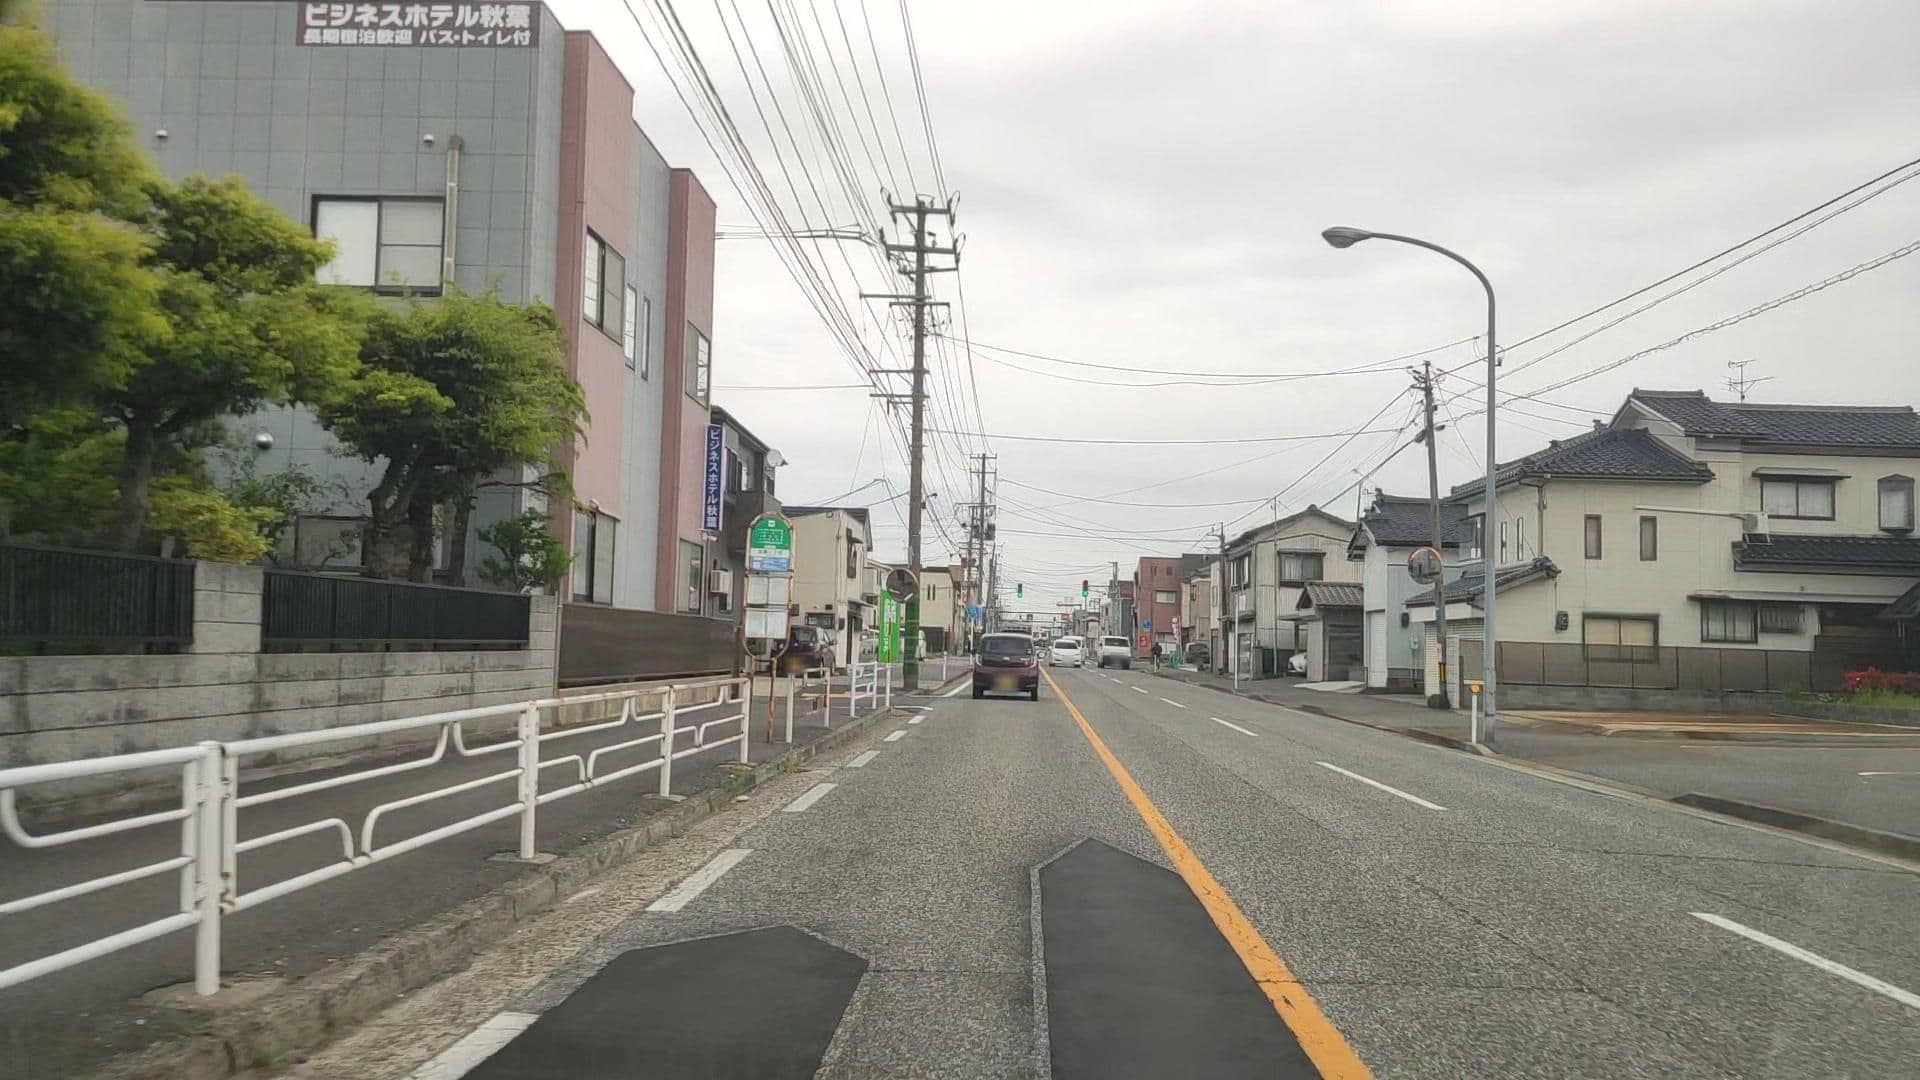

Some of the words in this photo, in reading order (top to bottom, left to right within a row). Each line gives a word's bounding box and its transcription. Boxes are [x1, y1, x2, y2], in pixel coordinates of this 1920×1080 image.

[304, 4, 531, 28] ビジネスホテル秋葉
